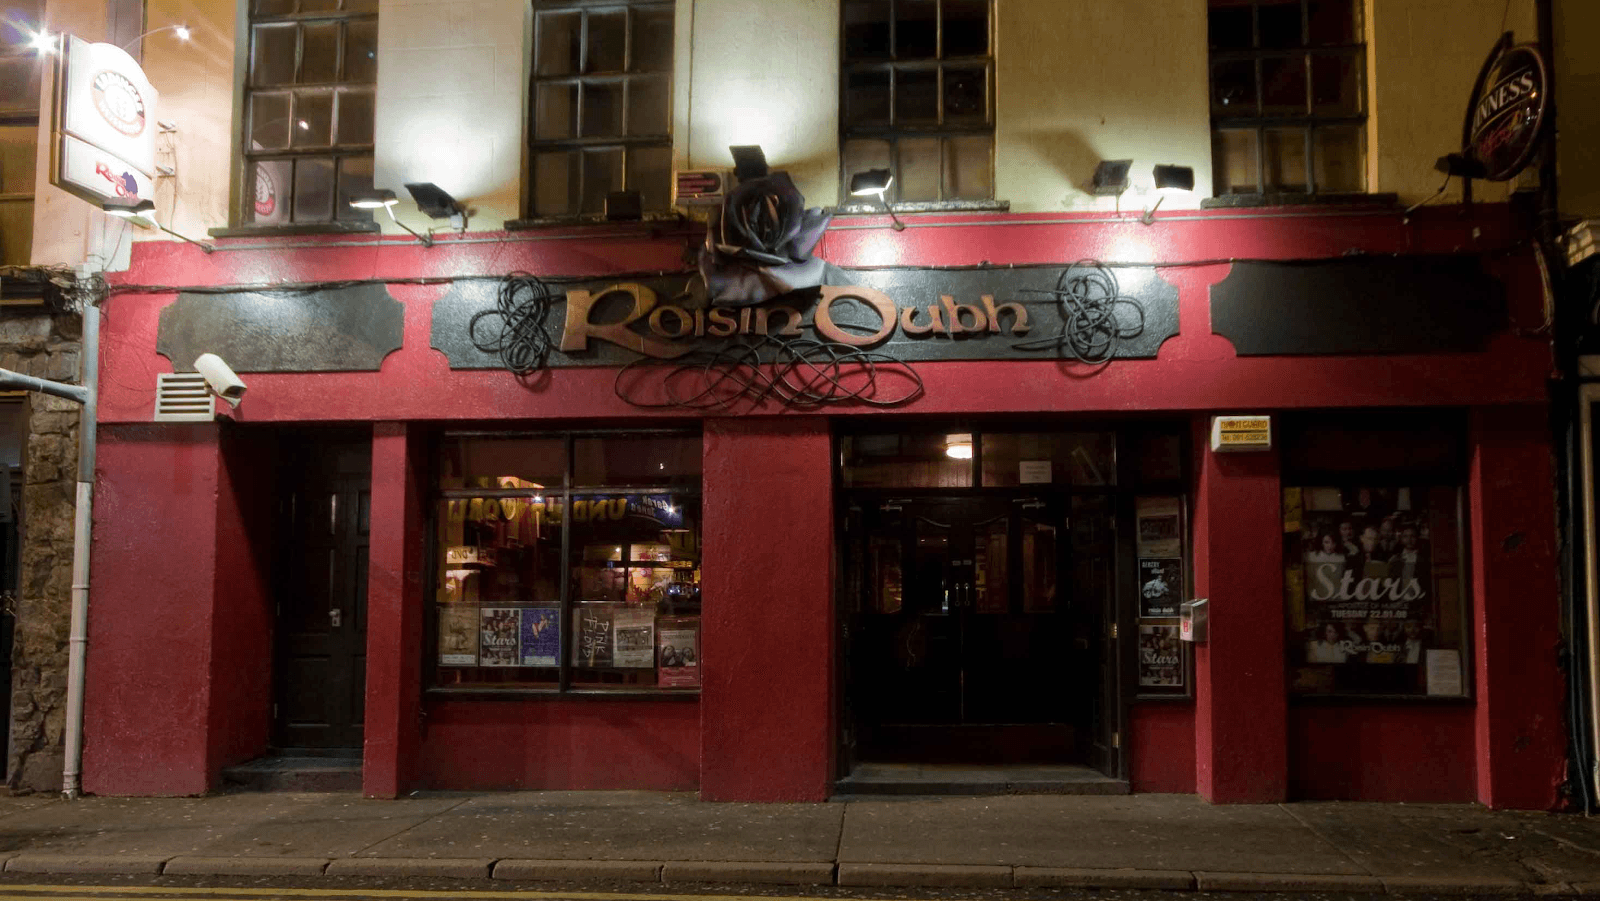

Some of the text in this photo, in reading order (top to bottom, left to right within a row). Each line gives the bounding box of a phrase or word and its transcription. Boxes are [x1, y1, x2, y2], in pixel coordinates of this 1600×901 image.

[1310, 563, 1427, 603] Stars
[1330, 609, 1369, 619] TUESDAY
[483, 632, 517, 646] Stars
[594, 619, 610, 655] PINK
[1141, 651, 1180, 666] Stars
